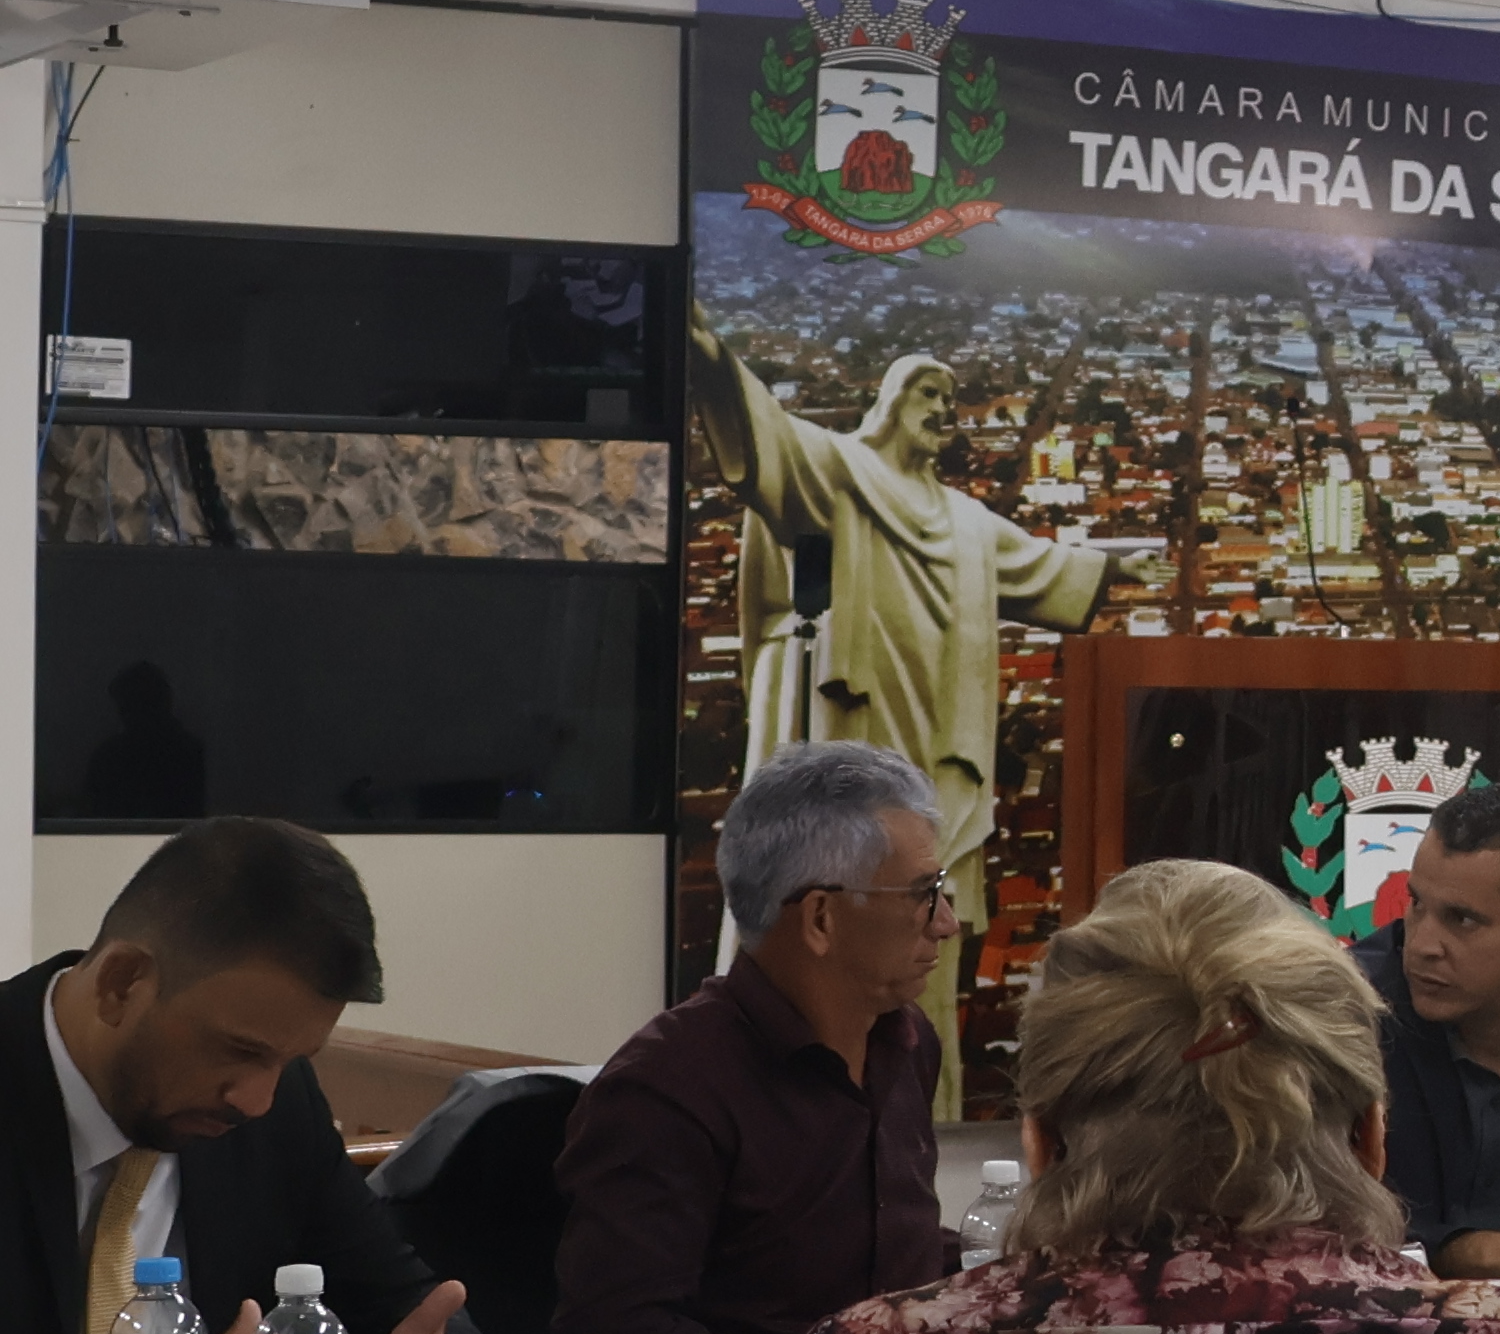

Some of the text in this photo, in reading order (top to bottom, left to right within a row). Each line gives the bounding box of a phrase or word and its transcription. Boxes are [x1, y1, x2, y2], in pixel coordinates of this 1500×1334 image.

[1074, 69, 1302, 122] CÂMARA
[1068, 130, 1372, 210] TANGARÁ
[1390, 160, 1475, 219] DA
[872, 236, 894, 249] DA
[895, 214, 946, 246] SERRA
